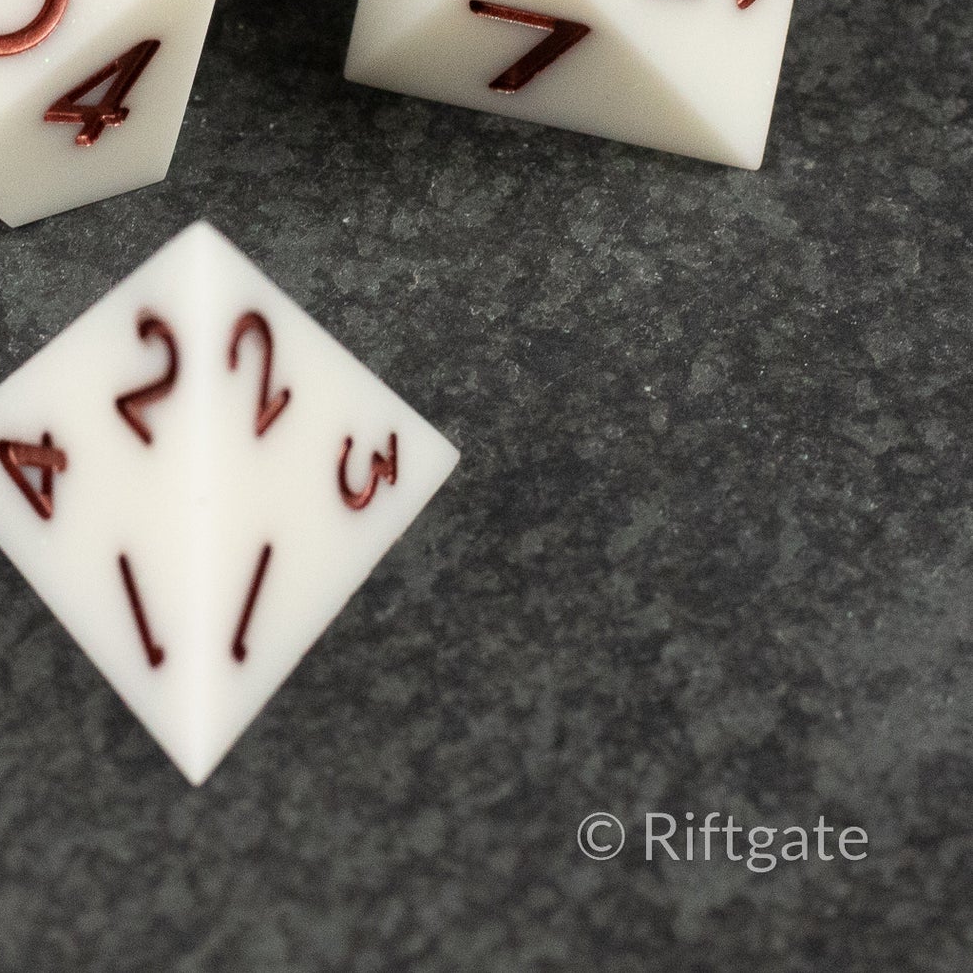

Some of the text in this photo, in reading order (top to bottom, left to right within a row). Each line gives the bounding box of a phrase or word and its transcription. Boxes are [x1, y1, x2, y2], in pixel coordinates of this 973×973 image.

[42, 37, 162, 149] 4
[114, 305, 182, 448] 2
[226, 309, 293, 440] 2
[335, 431, 399, 515] 3
